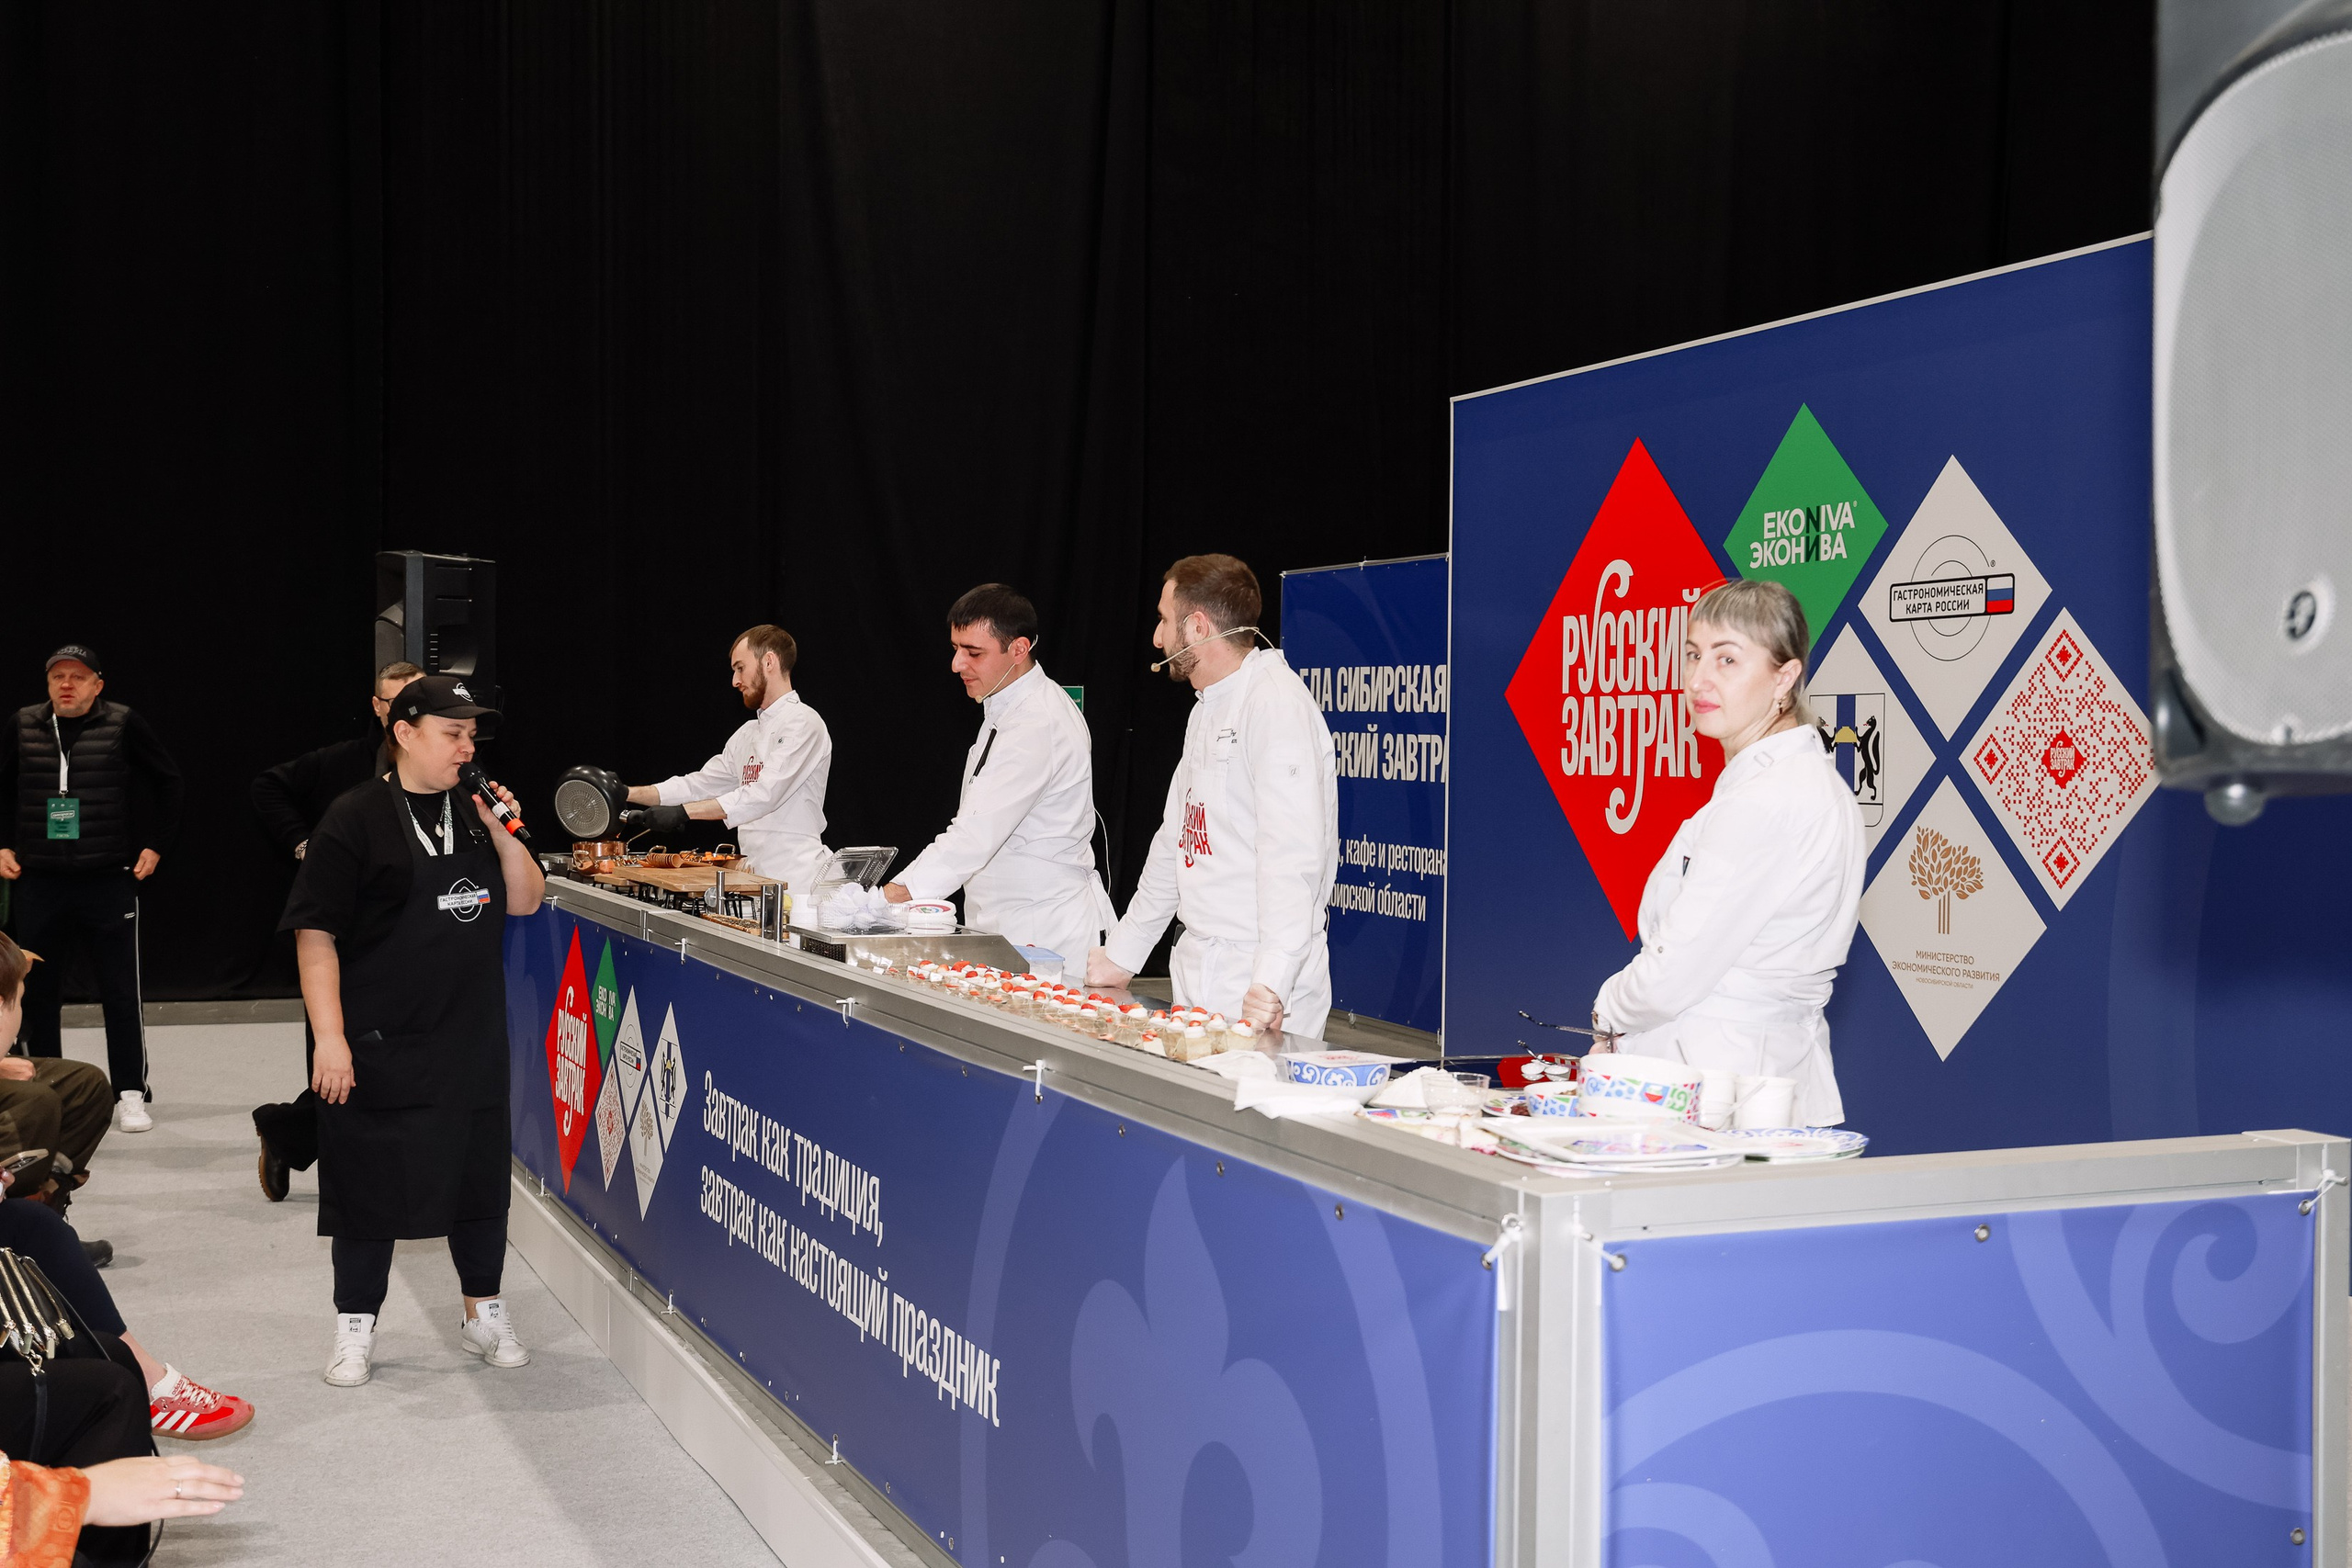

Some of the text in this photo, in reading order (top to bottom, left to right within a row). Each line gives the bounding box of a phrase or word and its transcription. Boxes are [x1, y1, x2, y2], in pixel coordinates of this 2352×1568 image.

[1763, 502, 1855, 539] EKONIVA
[1749, 532, 1848, 569] ЭКОНИВА
[1893, 582, 1984, 602] ГАСТРОНОМИЧЕСКАЯ
[1905, 599, 1970, 615] КАРТА РОССИИ
[1336, 664, 1447, 713] СИБИРСКАЯ
[1331, 724, 1447, 783] СКИЙ ЗАВТР
[1561, 694, 1702, 834] ЗАВТРАК
[1346, 834, 1376, 873] кафе
[1378, 842, 1385, 868] и
[1388, 844, 1446, 880] ресторан
[1378, 883, 1426, 921] области
[1893, 961, 2000, 982] ЭКОНОМИЧЕСКОГО РАЗВИТИЯ
[1916, 950, 1974, 964] МИНИСТЕРСТВО
[557, 986, 587, 1069] РУССКИЙ
[555, 1053, 586, 1137] ЗАВТРАК
[703, 1070, 884, 1247] Завтрак как традиция,
[700, 1165, 1001, 1427] завтрак как настоящий праздник
